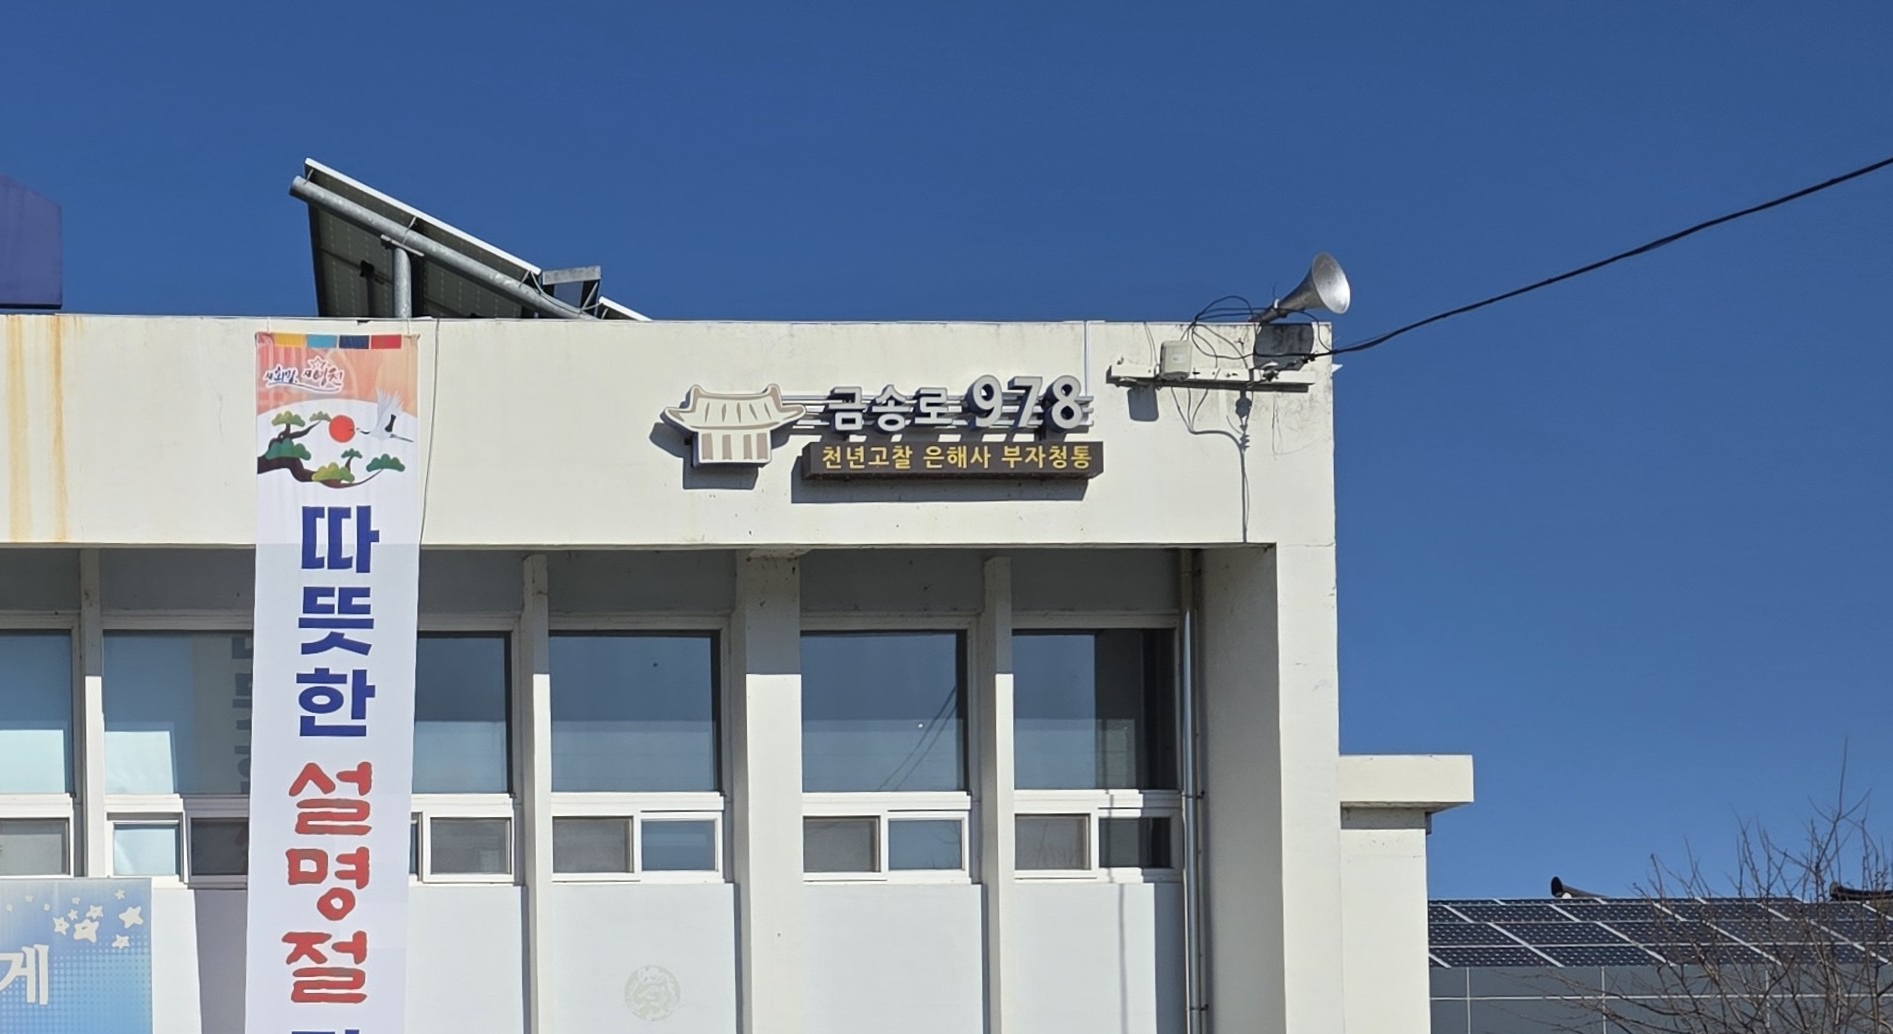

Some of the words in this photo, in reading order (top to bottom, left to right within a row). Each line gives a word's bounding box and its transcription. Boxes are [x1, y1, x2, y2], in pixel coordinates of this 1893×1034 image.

[821, 446, 913, 470] 천년고찰
[923, 446, 991, 469] 은해사
[1001, 446, 1093, 469] 부자청통
[828, 384, 951, 432] 금송로
[967, 375, 1084, 433] 978
[295, 504, 380, 738] 따뜻한
[281, 761, 373, 1004] 설명절
